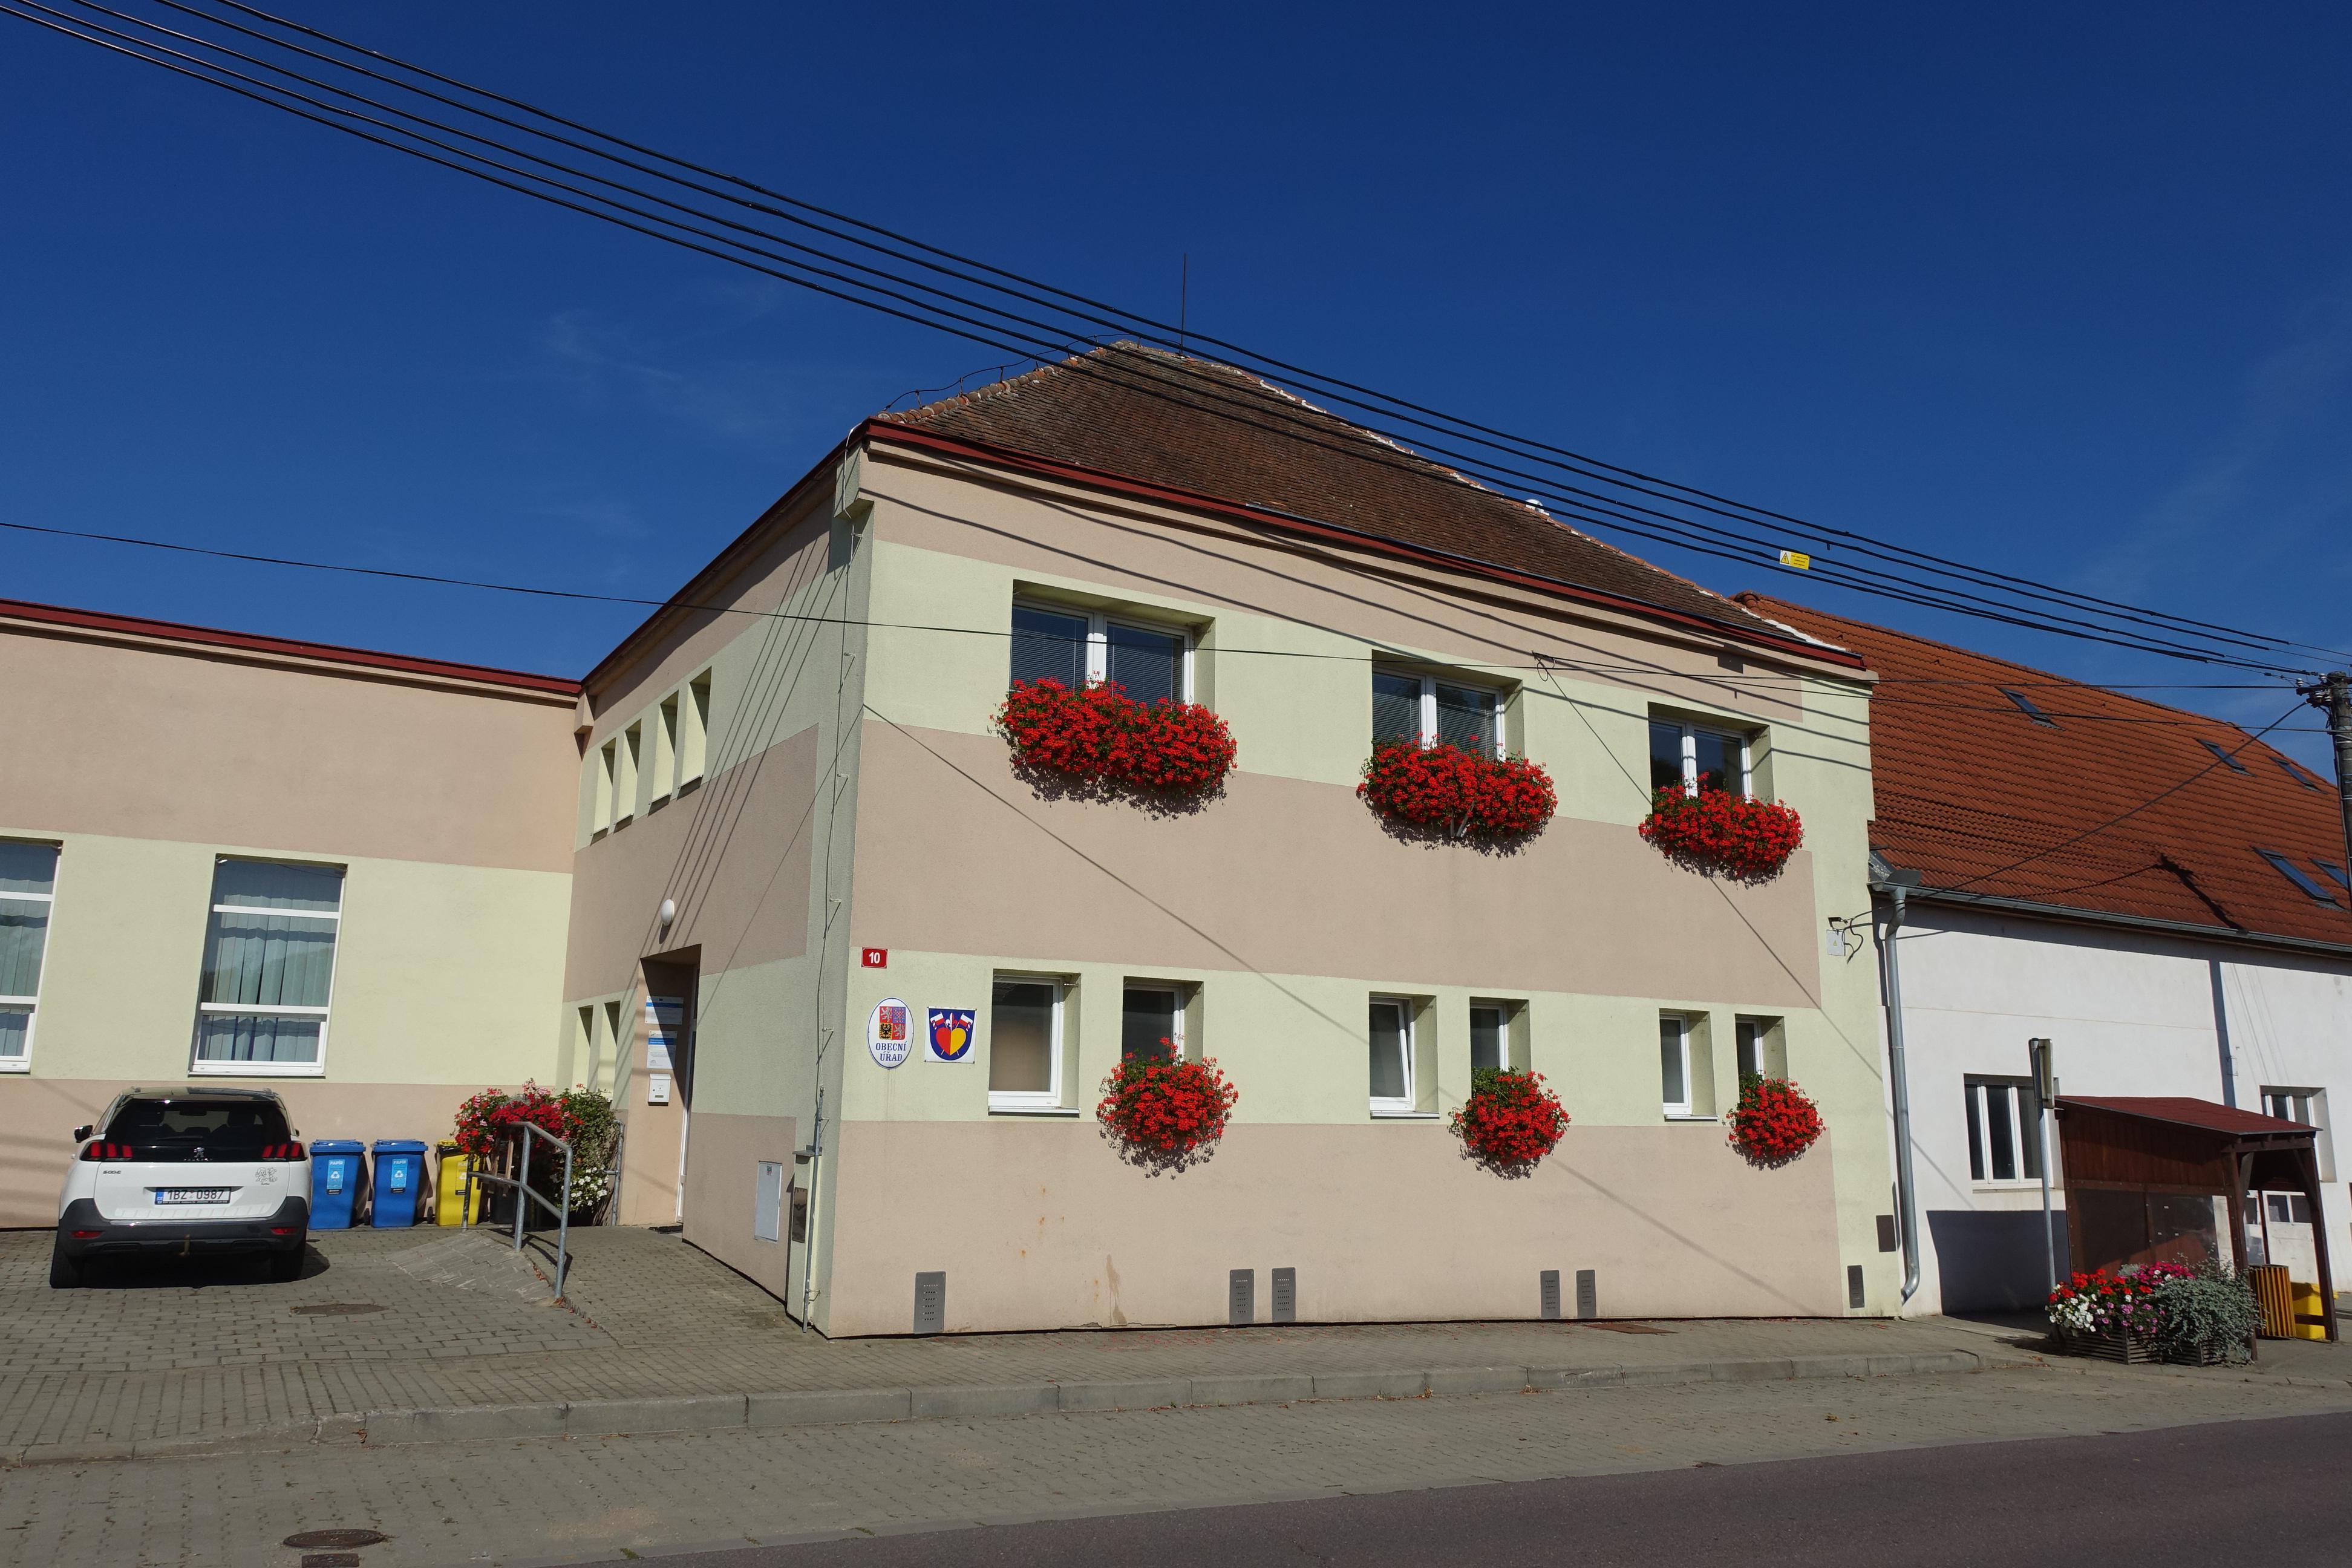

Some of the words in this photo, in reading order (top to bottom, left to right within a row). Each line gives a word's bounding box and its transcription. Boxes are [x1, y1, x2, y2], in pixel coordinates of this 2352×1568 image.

[869, 952, 881, 964] 10
[875, 1040, 907, 1051] OBECNÍ
[880, 1051, 903, 1061] ÚŘAD
[167, 1189, 188, 1200] 1BZ
[196, 1189, 224, 1199] 0987
